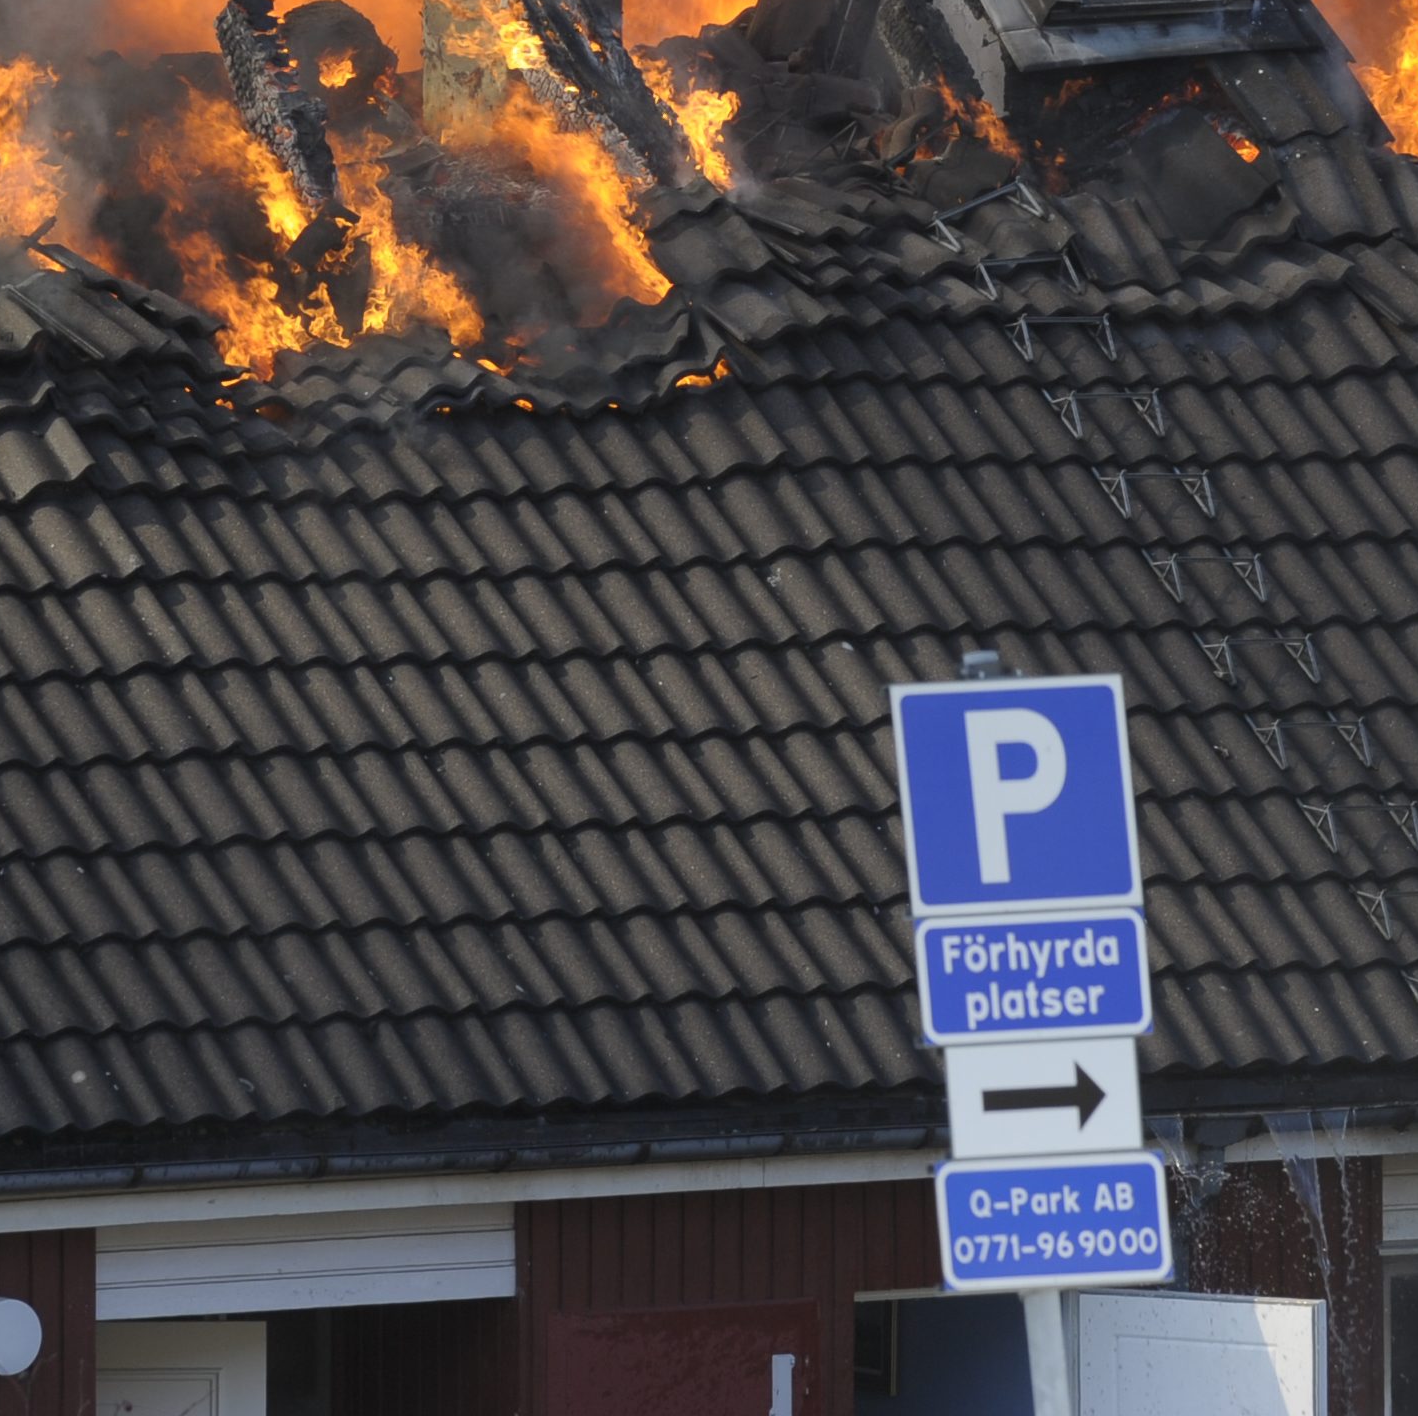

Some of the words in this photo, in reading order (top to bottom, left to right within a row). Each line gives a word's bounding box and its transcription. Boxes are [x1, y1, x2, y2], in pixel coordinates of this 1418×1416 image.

[965, 708, 1067, 884] P
[942, 929, 1120, 978] Förhyrda
[965, 982, 1105, 1030] platser
[969, 1185, 1081, 1218] Q-Park
[1093, 1181, 1135, 1212] AB
